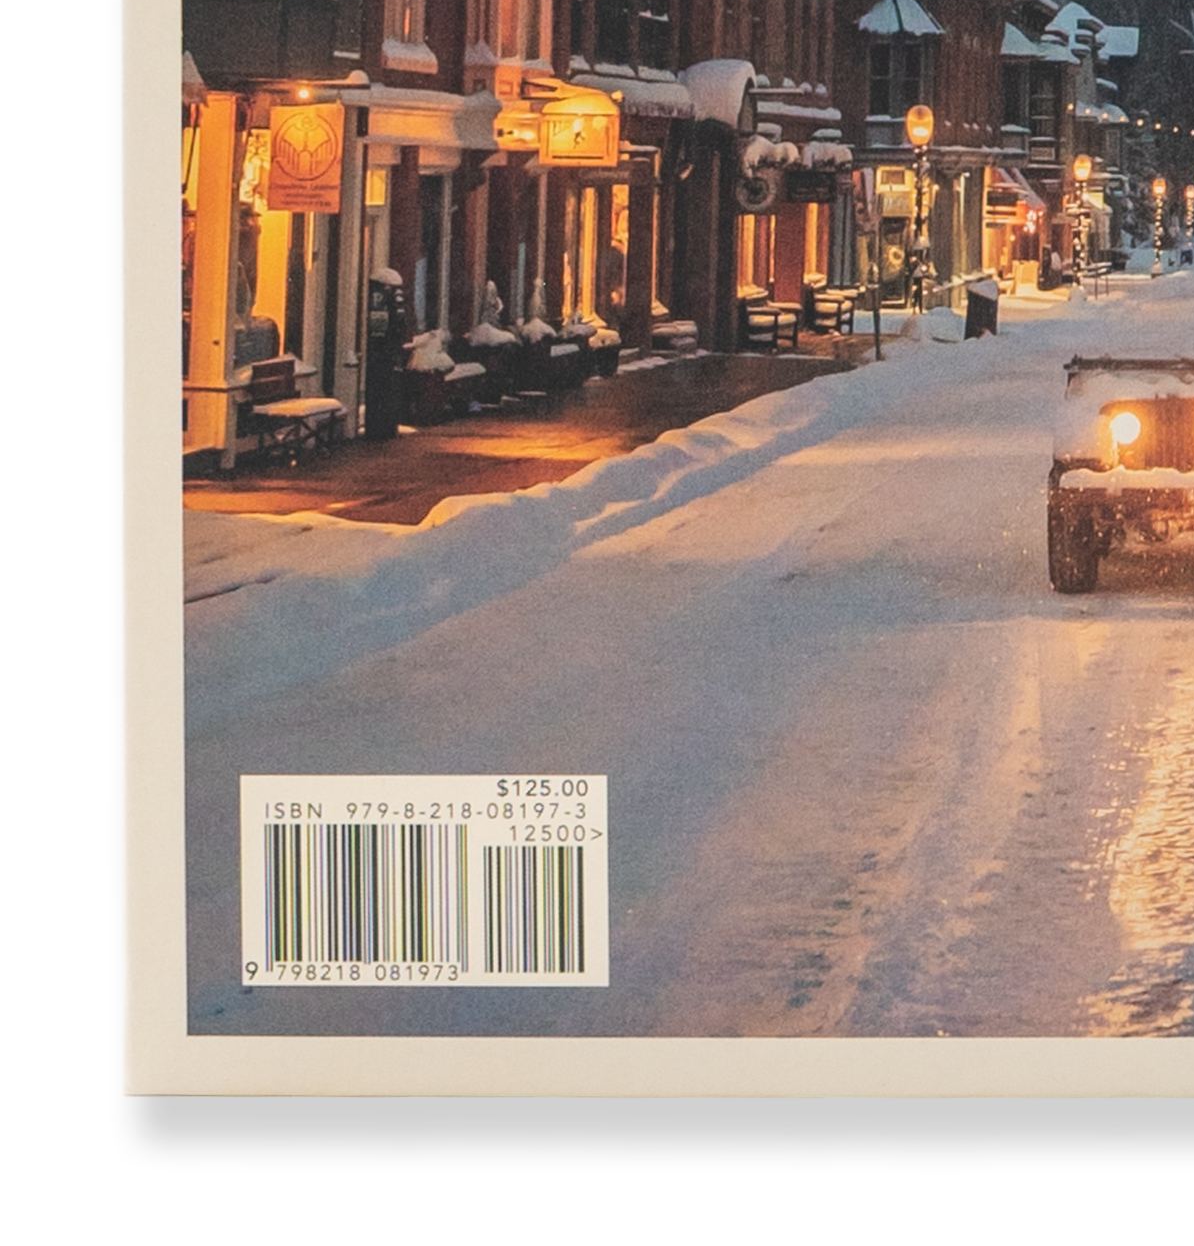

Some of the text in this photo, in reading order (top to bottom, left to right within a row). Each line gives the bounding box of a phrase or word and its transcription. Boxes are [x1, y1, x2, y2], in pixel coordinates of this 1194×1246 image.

[496, 778, 589, 798] $125.00
[265, 802, 587, 820] ISBN 979-8-218-08197-3
[245, 960, 459, 981] 9 798218 081973
